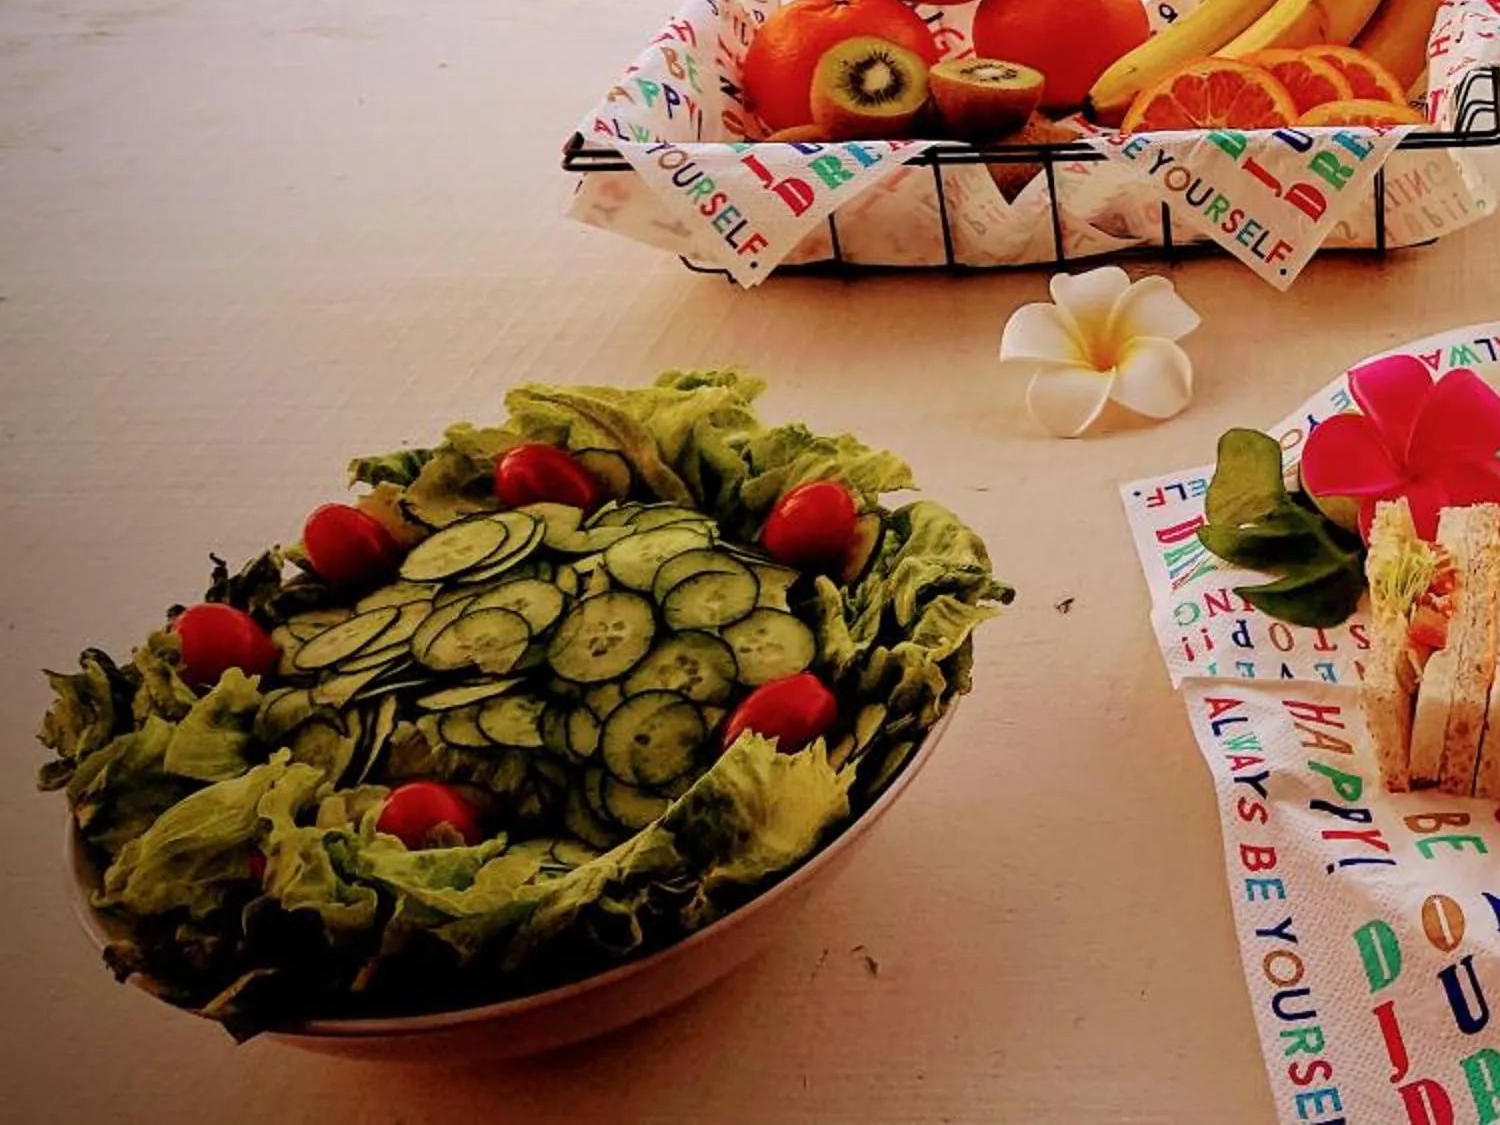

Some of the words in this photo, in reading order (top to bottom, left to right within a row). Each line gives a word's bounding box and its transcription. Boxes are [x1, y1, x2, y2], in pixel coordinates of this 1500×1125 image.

[646, 137, 769, 269] YOURSELF.
[1149, 149, 1294, 276] YOURSELF.
[1203, 696, 1272, 826] ALWAYS
[1238, 842, 1287, 903] BE
[1281, 699, 1397, 875] HAPPY!
[1402, 811, 1489, 860] BE
